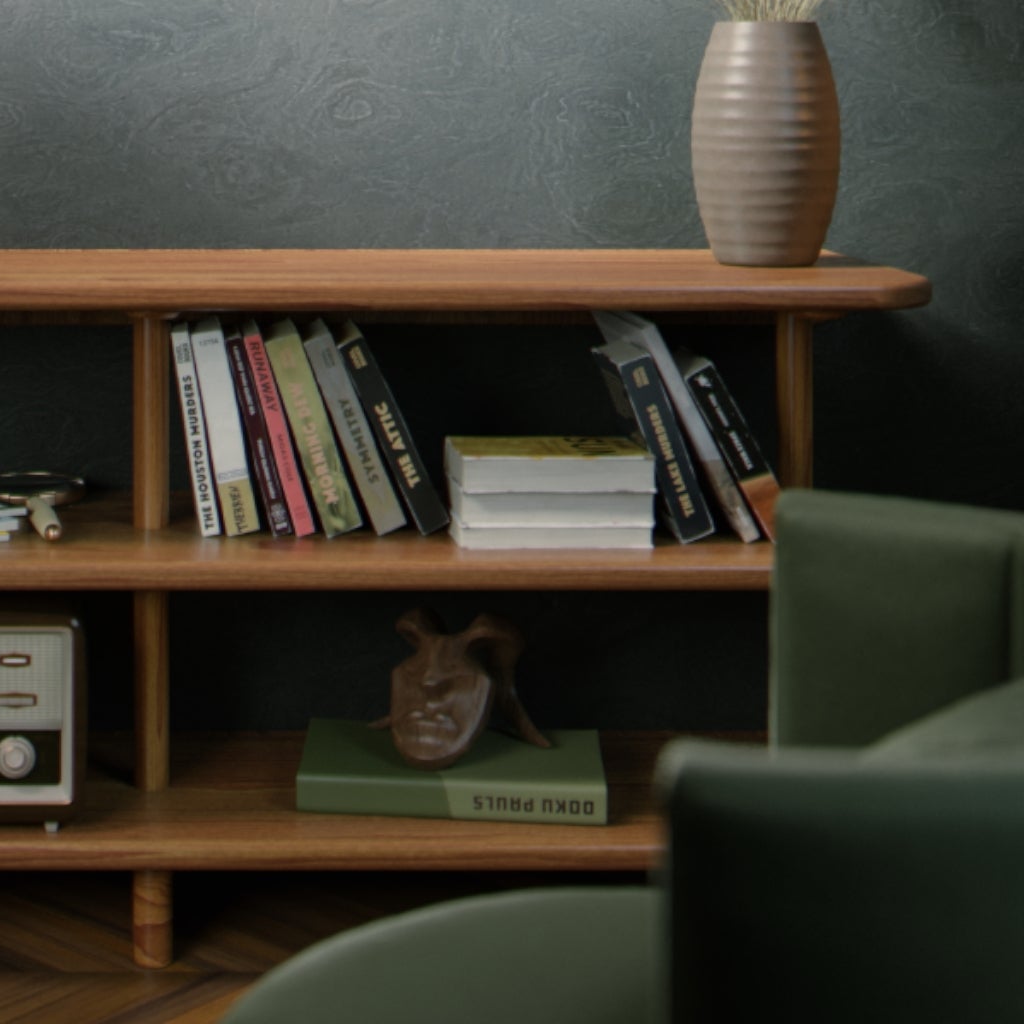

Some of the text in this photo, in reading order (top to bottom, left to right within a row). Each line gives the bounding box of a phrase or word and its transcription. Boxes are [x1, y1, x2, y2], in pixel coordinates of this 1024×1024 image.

[182, 374, 200, 436] MURDERS
[249, 341, 278, 412] RUNAWAY
[191, 439, 211, 502] HOUSTON
[288, 382, 339, 505] MORNING DEW
[337, 397, 380, 484] SYMMETRY
[374, 401, 422, 489] THE ATTIC
[646, 403, 695, 519] THE LAKE MURDERS
[201, 505, 215, 530] THE
[472, 795, 595, 816] DOKU PAULS
